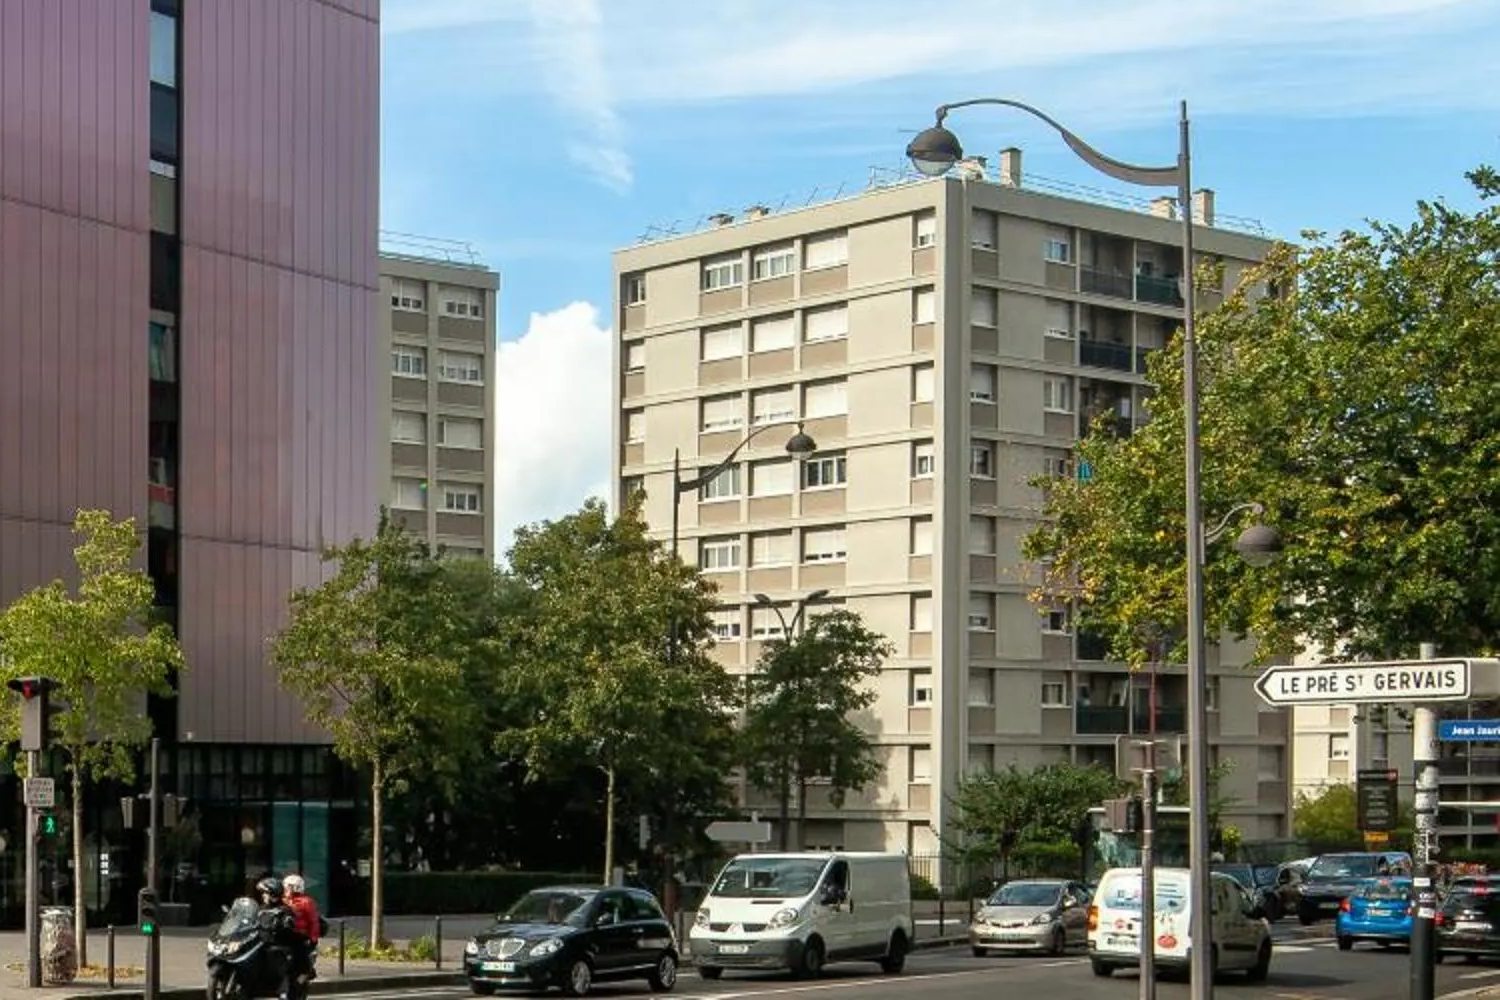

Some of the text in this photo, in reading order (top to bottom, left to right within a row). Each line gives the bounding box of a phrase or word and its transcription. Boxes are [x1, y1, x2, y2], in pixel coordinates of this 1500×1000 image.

[1280, 677, 1300, 694] LE
[1306, 671, 1339, 693] PRÉ
[1374, 670, 1457, 691] GERVAIS
[1451, 724, 1475, 736] Jean
